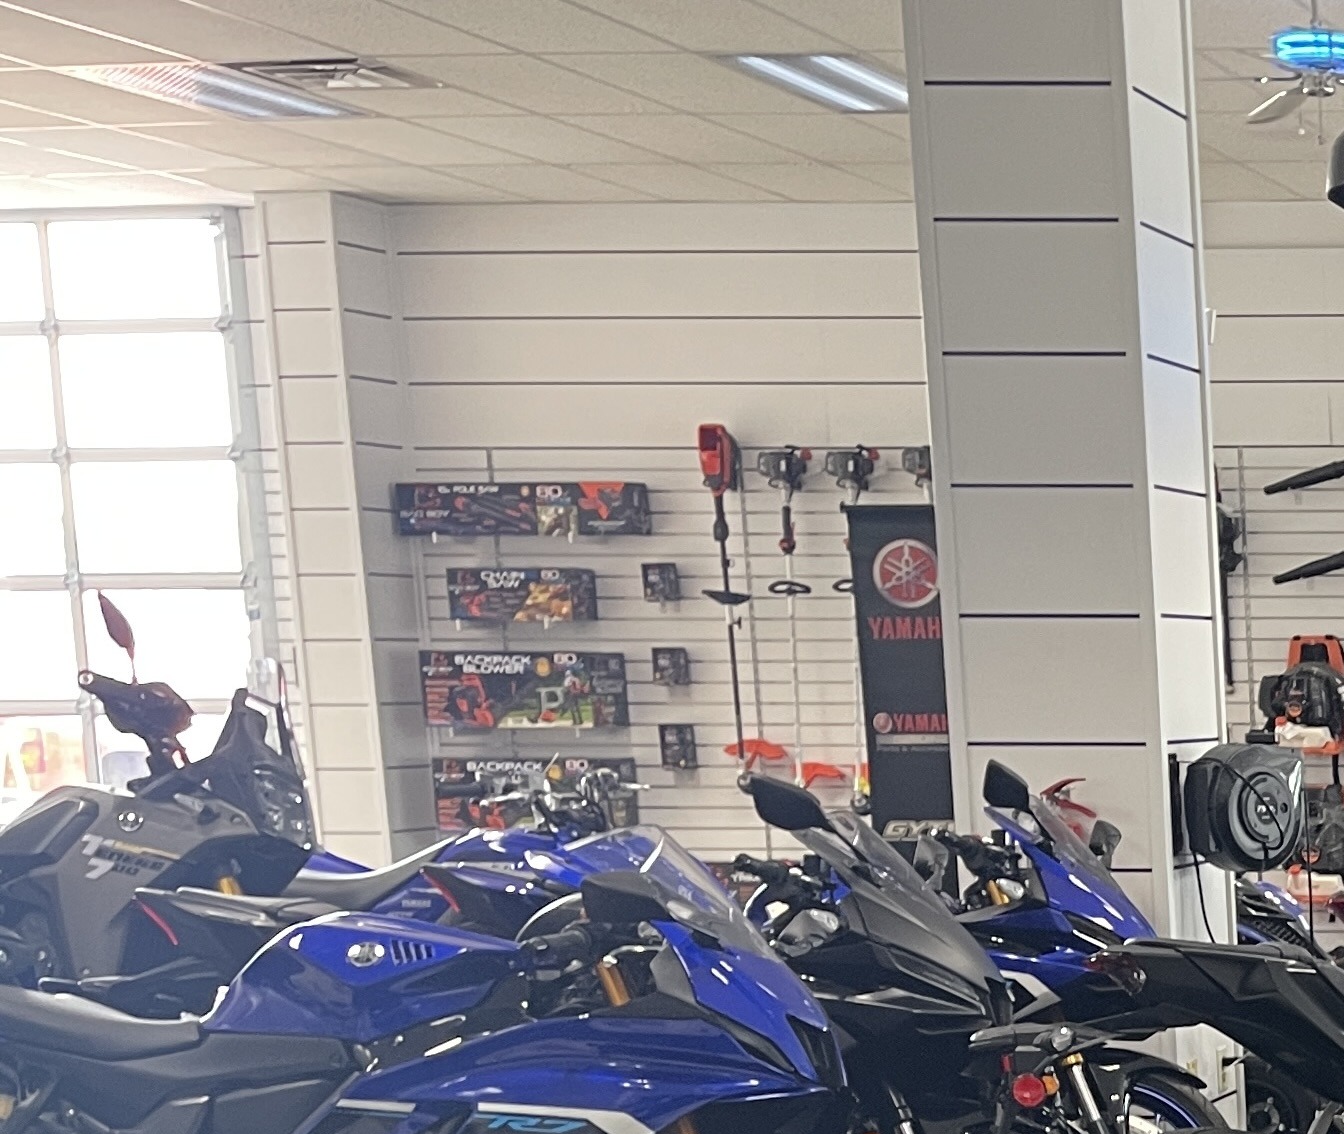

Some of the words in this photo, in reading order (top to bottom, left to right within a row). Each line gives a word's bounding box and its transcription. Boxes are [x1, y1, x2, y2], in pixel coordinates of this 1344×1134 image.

[454, 654, 531, 665] BACKPACK
[463, 664, 525, 674] BLOWER
[466, 761, 543, 773] BACKPACK
